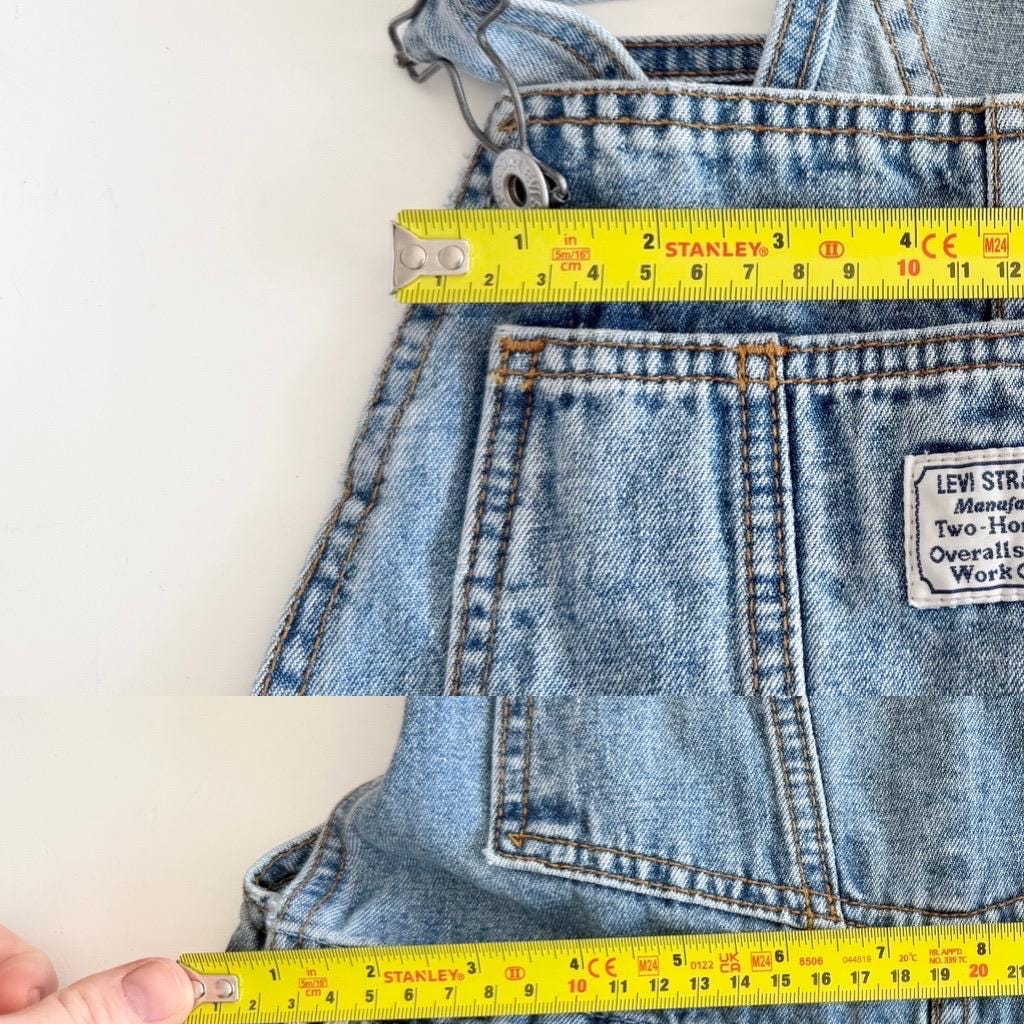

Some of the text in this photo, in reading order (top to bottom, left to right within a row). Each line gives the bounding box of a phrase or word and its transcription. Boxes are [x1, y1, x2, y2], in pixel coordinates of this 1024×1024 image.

[514, 234, 523, 250] 1
[643, 234, 654, 249] 2
[773, 233, 784, 248] 3
[900, 233, 911, 248] 4
[564, 235, 576, 246] in
[922, 234, 957, 258] CE
[985, 237, 1007, 253] M24
[484, 273, 494, 286] 2
[536, 273, 546, 286] 3
[587, 265, 599, 280] 4
[640, 265, 651, 280] 5
[691, 265, 703, 280] 6
[743, 264, 754, 279] 7
[793, 264, 804, 279] 8
[843, 263, 855, 279] 9
[897, 260, 920, 276] 10
[947, 263, 970, 278] 11
[997, 263, 1021, 277] 12
[561, 261, 581, 272] cm
[937, 473, 975, 494] LEVI
[930, 542, 1024, 563] Overalls
[950, 563, 1012, 584] Work
[269, 968, 277, 981] 1
[366, 965, 375, 978] 2
[467, 962, 476, 974] 3
[570, 958, 579, 970] 4
[673, 953, 682, 966] 5
[775, 950, 784, 963] 6
[876, 947, 885, 959] 7
[977, 942, 986, 955] 8
[588, 957, 616, 978] CE
[640, 958, 658, 972] M24
[691, 960, 714, 970] 0122
[719, 952, 739, 962] UK
[752, 954, 823, 968] M24 8506
[568, 980, 587, 993] 10
[969, 964, 988, 977] 20
[719, 963, 741, 973] CA
